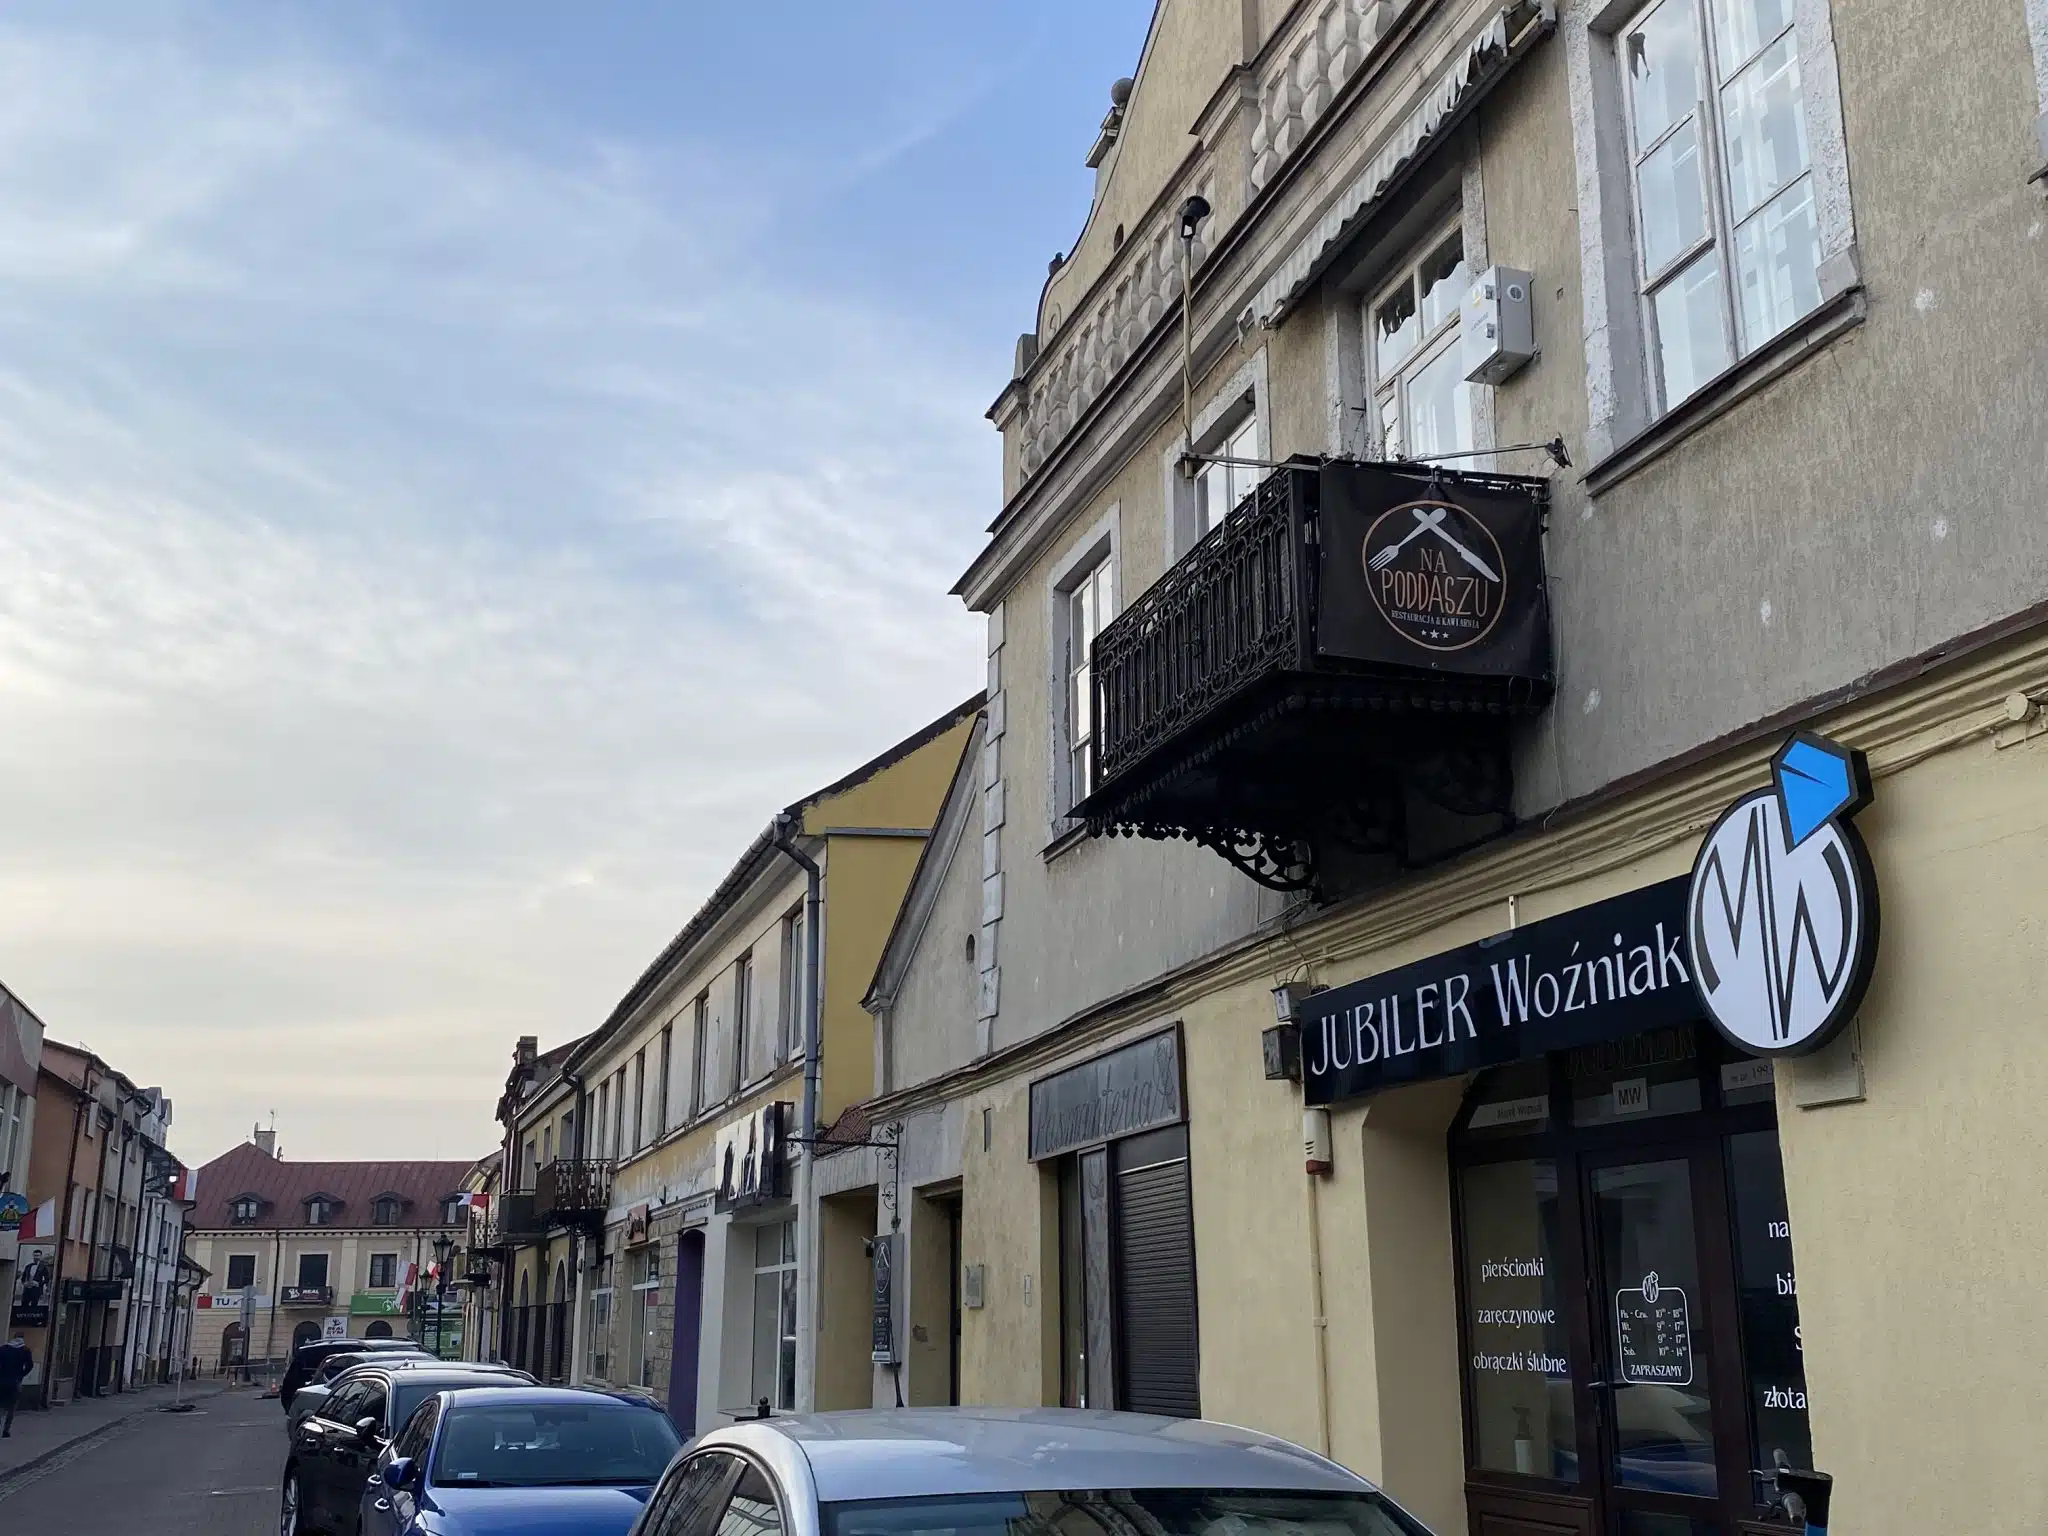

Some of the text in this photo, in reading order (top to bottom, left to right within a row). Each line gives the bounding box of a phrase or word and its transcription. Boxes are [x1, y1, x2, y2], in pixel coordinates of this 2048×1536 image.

[1420, 548, 1449, 574] NA
[1381, 568, 1489, 617] PODDASZU
[1391, 609, 1435, 625] RESTAURACJA
[1311, 973, 1477, 1076] JUBILER
[1490, 921, 1690, 1027] Woźniak
[1618, 1086, 1641, 1106] MW
[1481, 1256, 1545, 1283] pierścionki
[1477, 1308, 1556, 1329] zaręczynowe
[1473, 1350, 1567, 1375] obrączki ślubne
[1630, 1364, 1682, 1377] ZAPRASZAMY
[1764, 1386, 1807, 1409] złota
